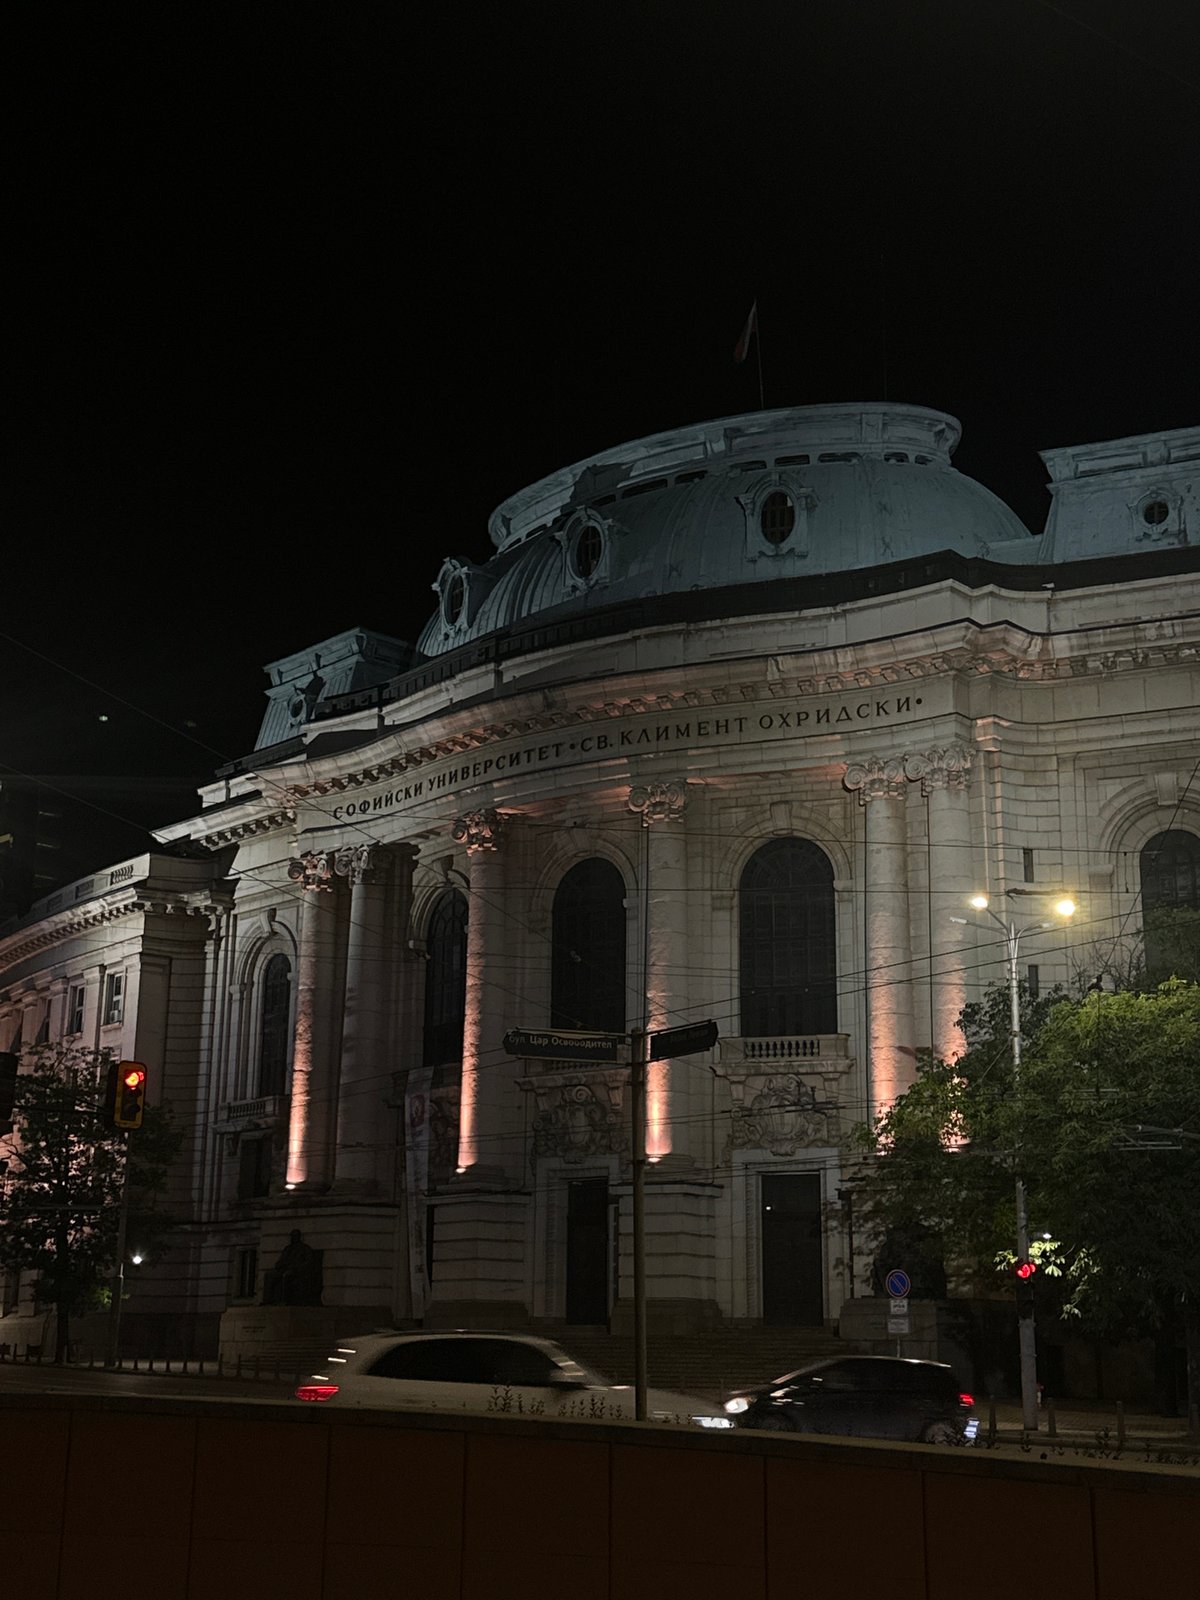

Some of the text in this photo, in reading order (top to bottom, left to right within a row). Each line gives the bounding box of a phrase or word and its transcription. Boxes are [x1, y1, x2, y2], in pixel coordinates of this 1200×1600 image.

[333, 696, 911, 820] СОФИЙСКИ УНИВЕРСИТЕТ СВ. КЛИМЕНТ ОХРИДСКИ
[529, 1035, 549, 1047] Цар
